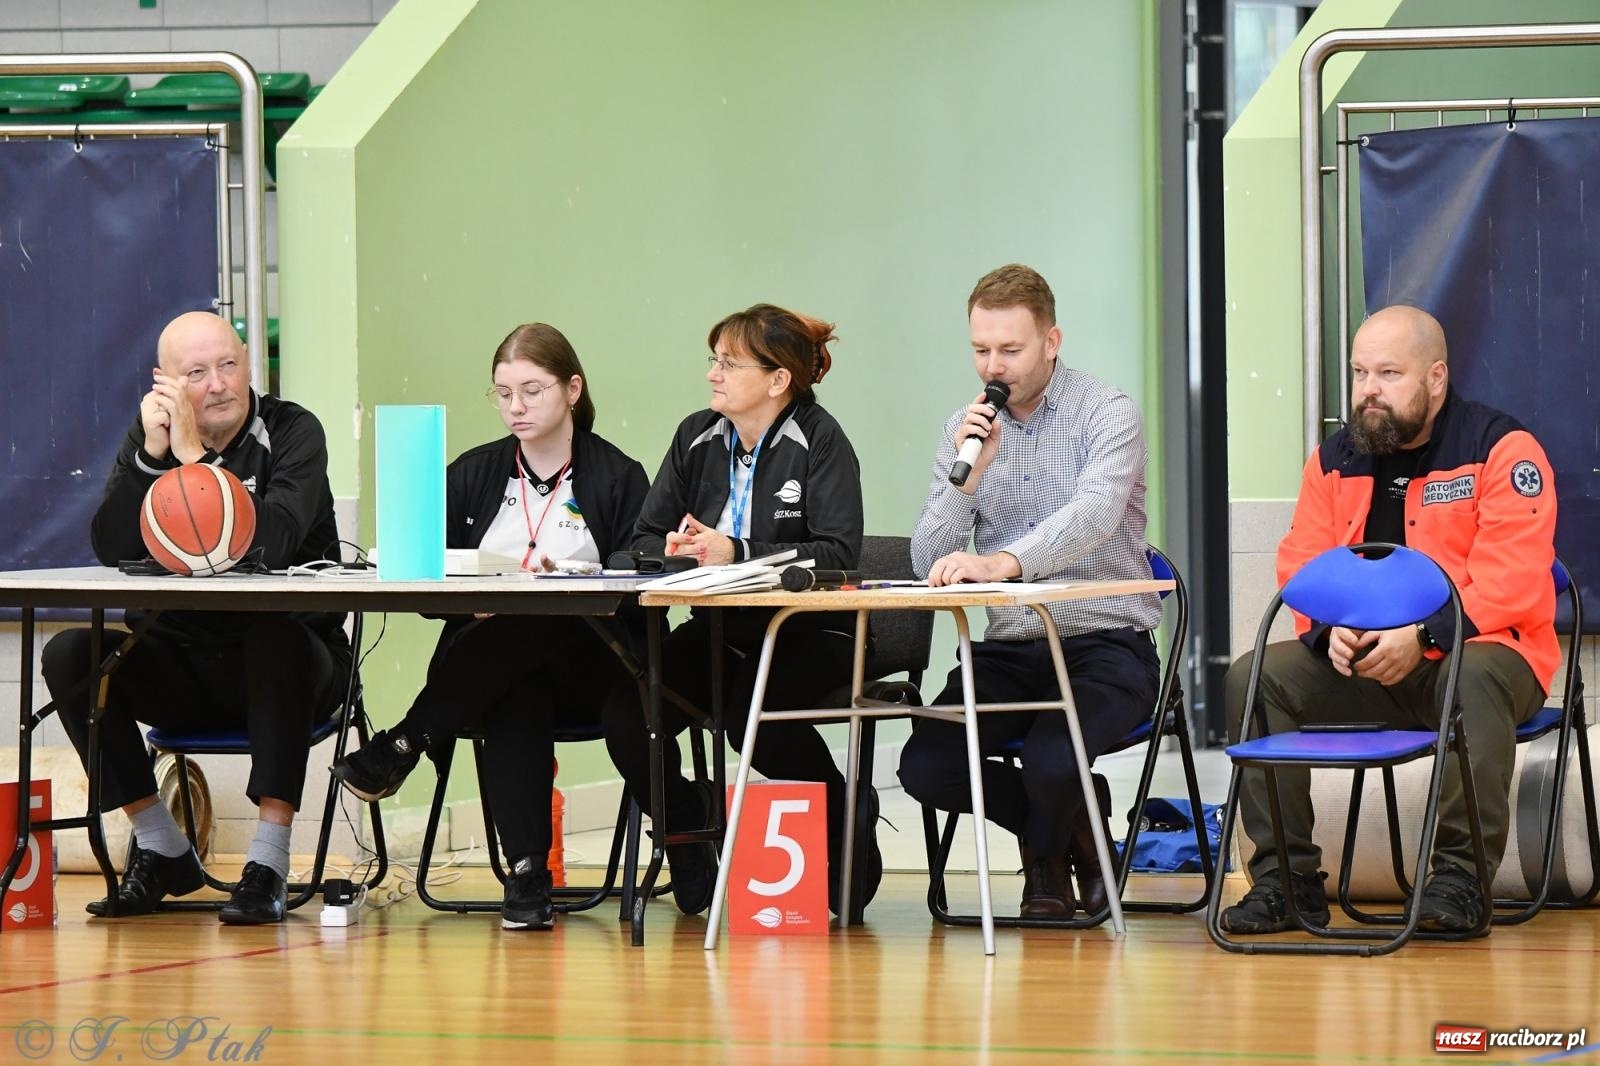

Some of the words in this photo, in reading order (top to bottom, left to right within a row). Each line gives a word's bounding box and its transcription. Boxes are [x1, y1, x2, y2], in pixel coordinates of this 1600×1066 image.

[1424, 478, 1472, 494] RATOWNIK
[1424, 487, 1473, 503] MEDYCZNY
[746, 799, 811, 897] 5
